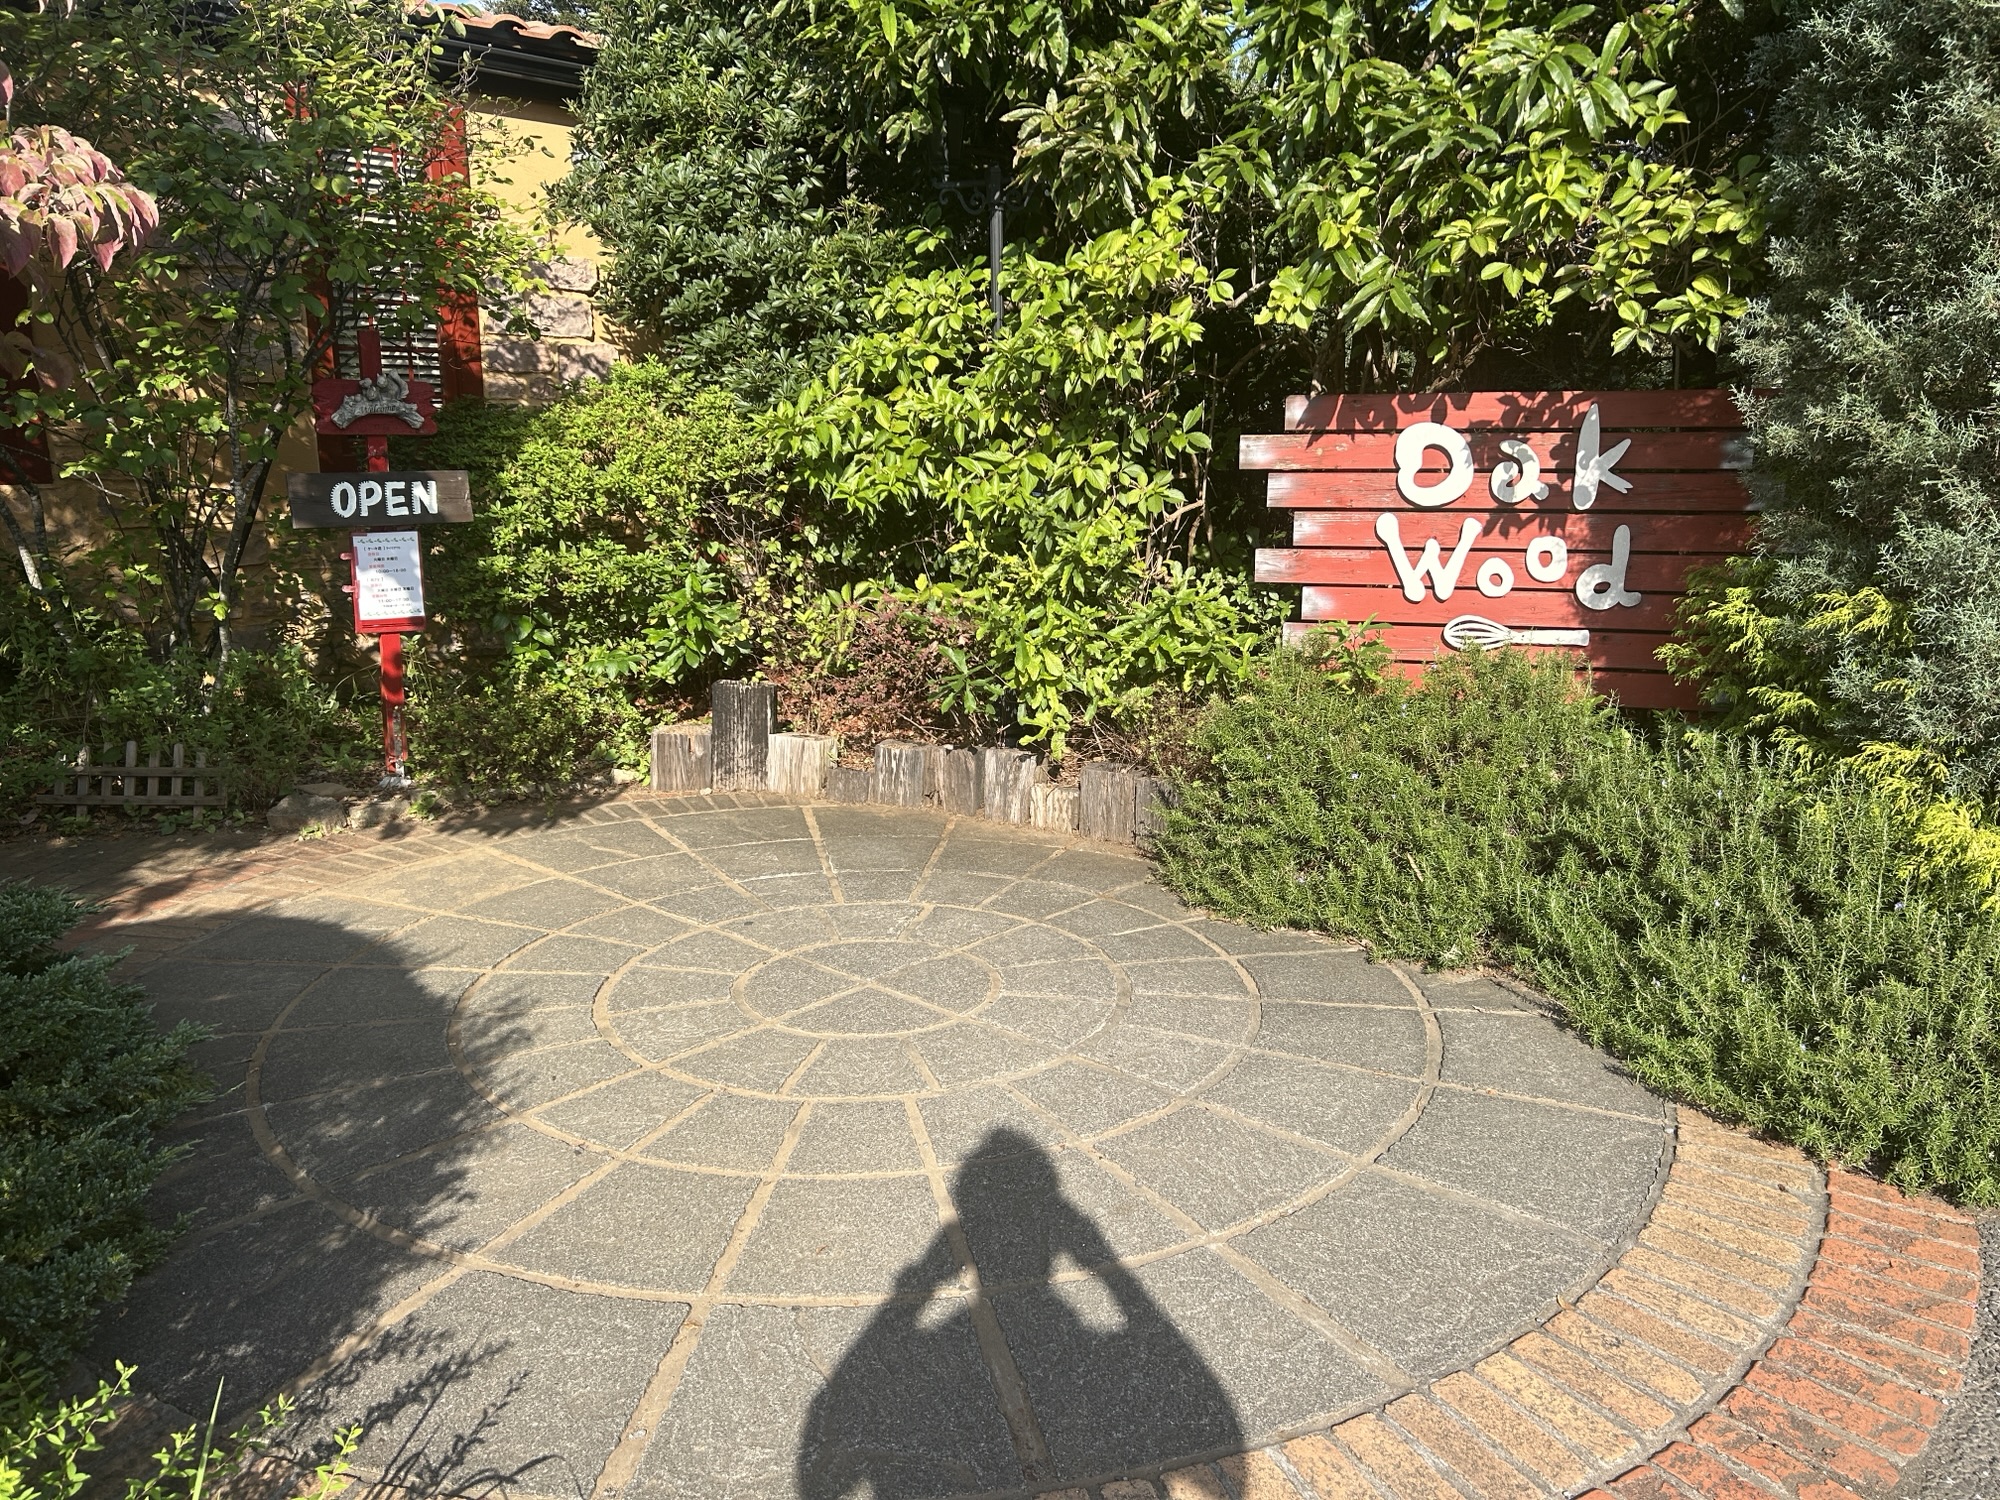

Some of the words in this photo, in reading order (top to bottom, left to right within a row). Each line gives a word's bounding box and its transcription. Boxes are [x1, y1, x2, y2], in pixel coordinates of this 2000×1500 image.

[330, 480, 438, 518] OPEN
[1395, 403, 1633, 510] Oak
[1376, 512, 1641, 610] Wood
